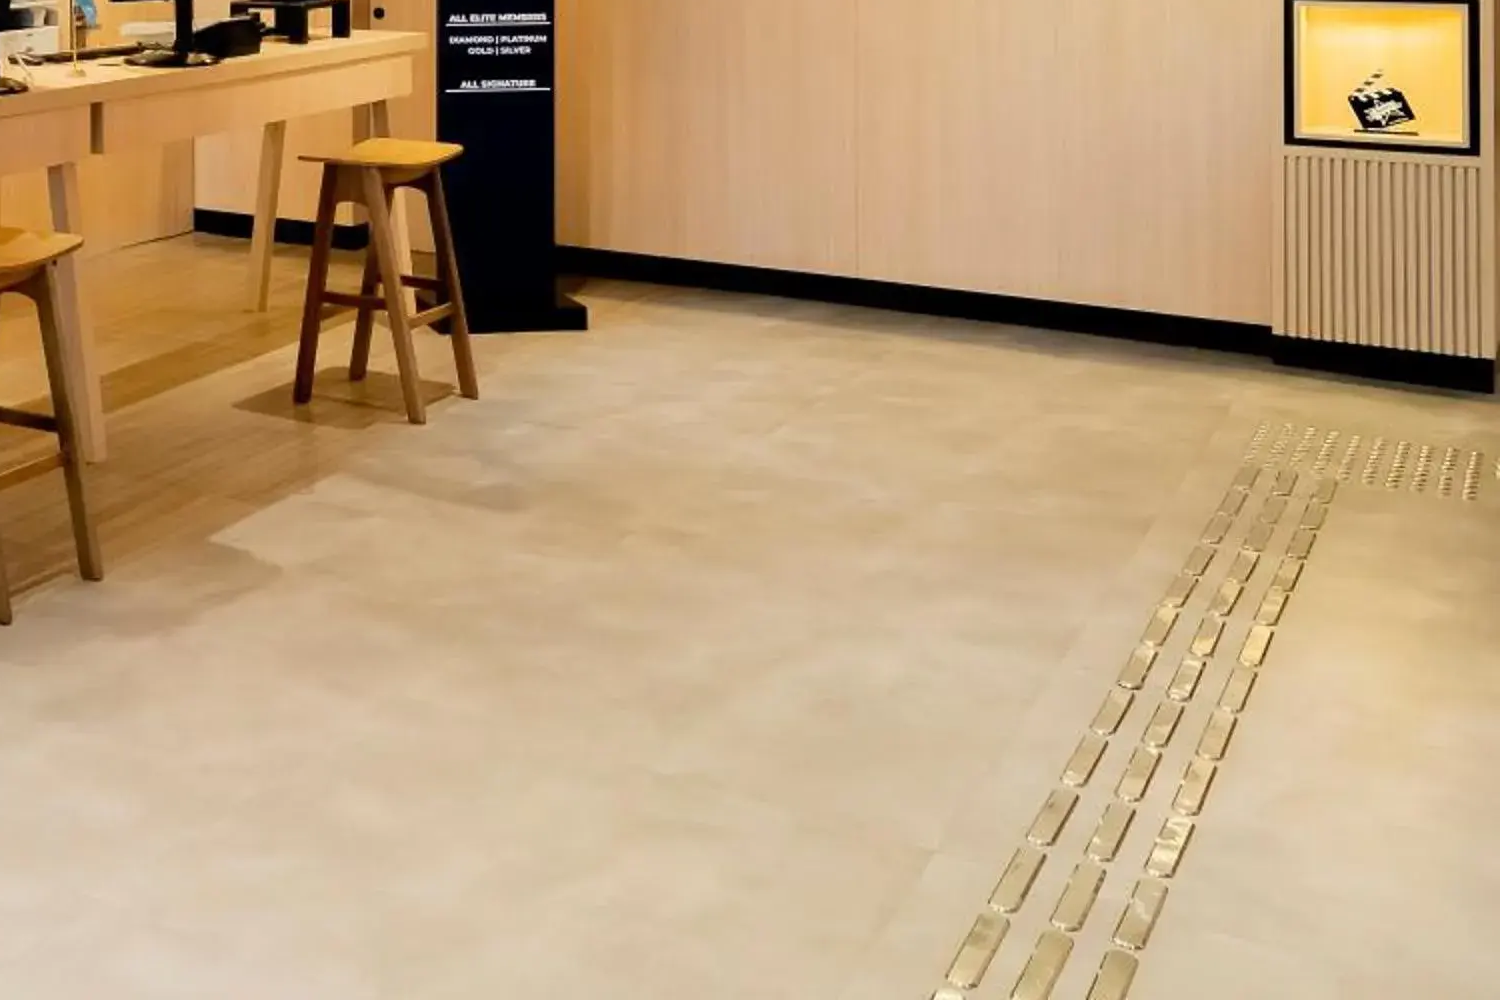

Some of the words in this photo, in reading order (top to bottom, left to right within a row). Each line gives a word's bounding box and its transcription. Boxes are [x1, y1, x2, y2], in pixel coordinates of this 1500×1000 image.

[449, 14, 468, 23] ALL
[469, 13, 496, 22] ELITE
[449, 35, 495, 44] DIAMOND
[500, 35, 547, 43] PLATINUM
[467, 47, 495, 55] GOLD
[500, 46, 531, 55] SILVER
[460, 80, 479, 89] ALL
[481, 80, 536, 88] SIGNATURE
